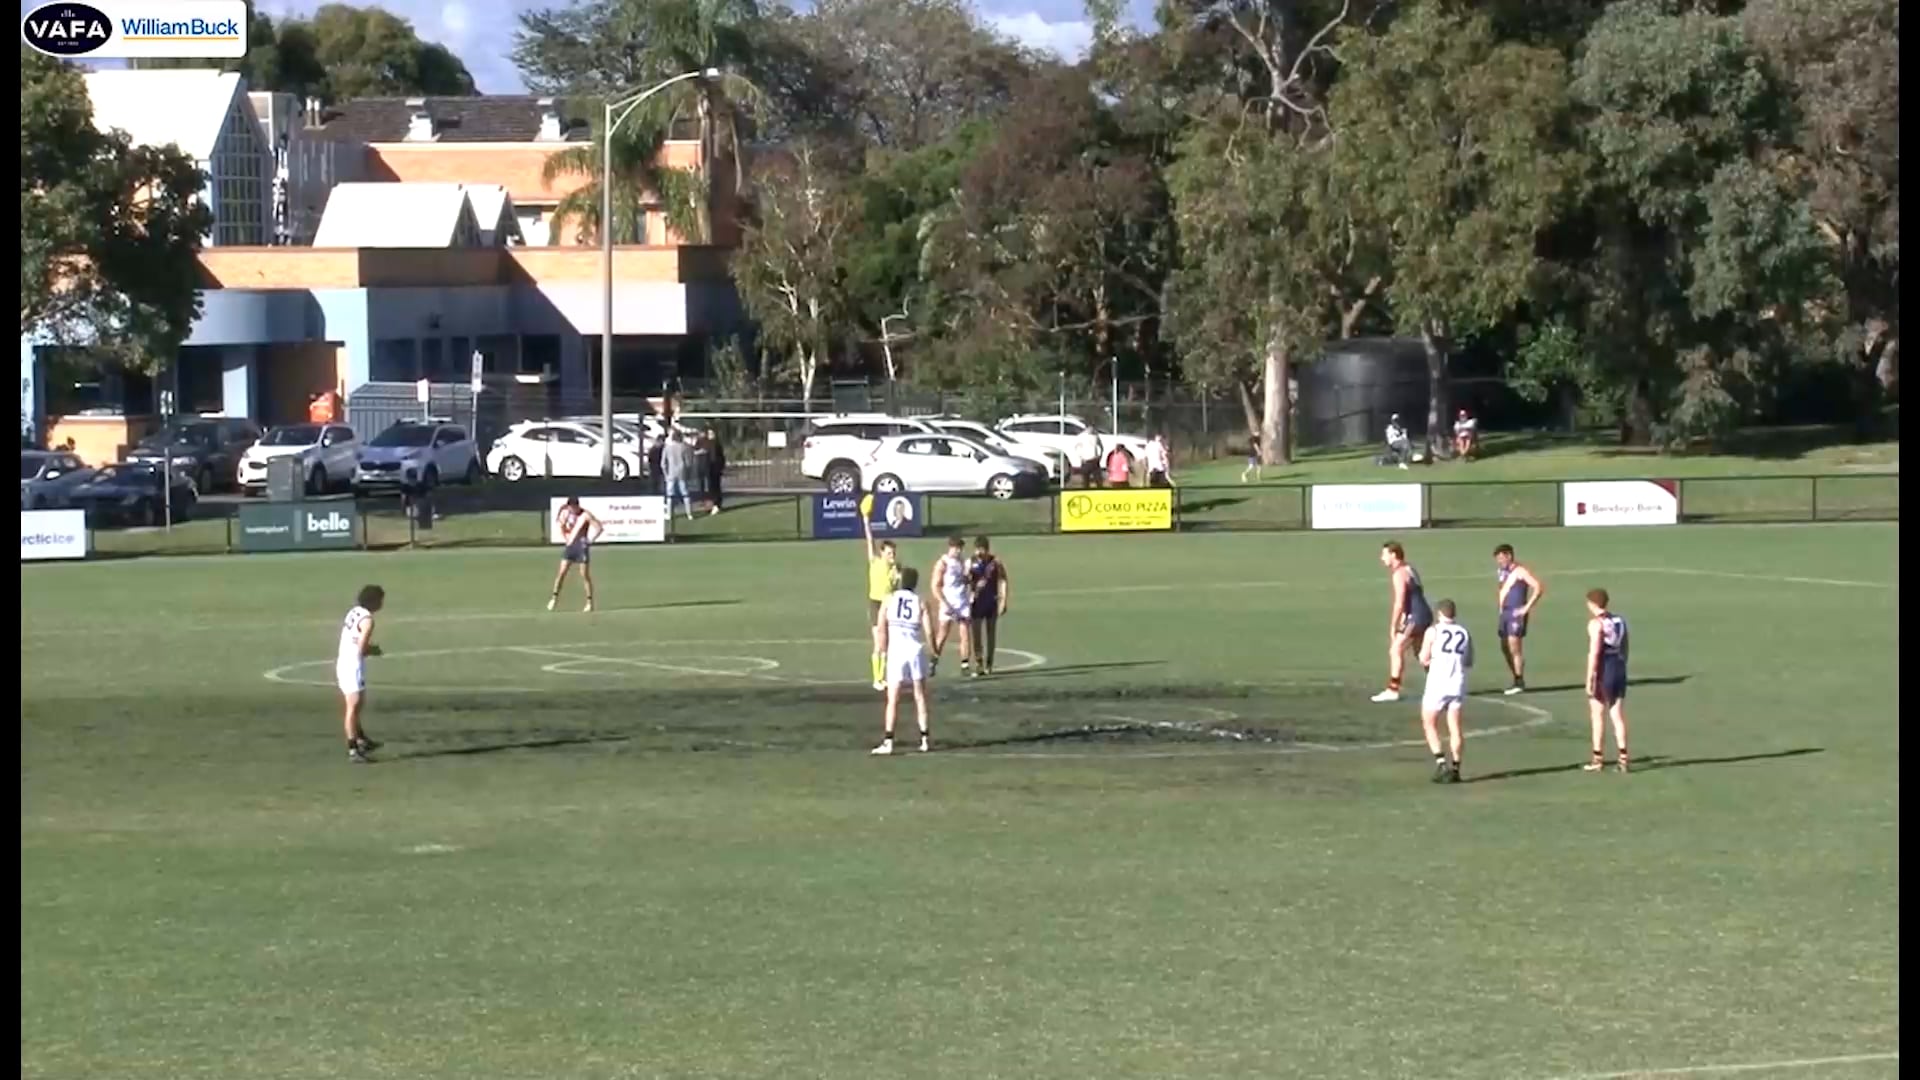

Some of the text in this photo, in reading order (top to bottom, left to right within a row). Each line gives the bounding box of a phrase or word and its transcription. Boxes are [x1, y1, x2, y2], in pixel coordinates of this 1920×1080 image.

[823, 498, 857, 509] Lewin
[1095, 502, 1168, 513] COMO PIZZA
[307, 511, 351, 532] belle
[897, 597, 913, 620] 15
[1441, 629, 1466, 655] 22
